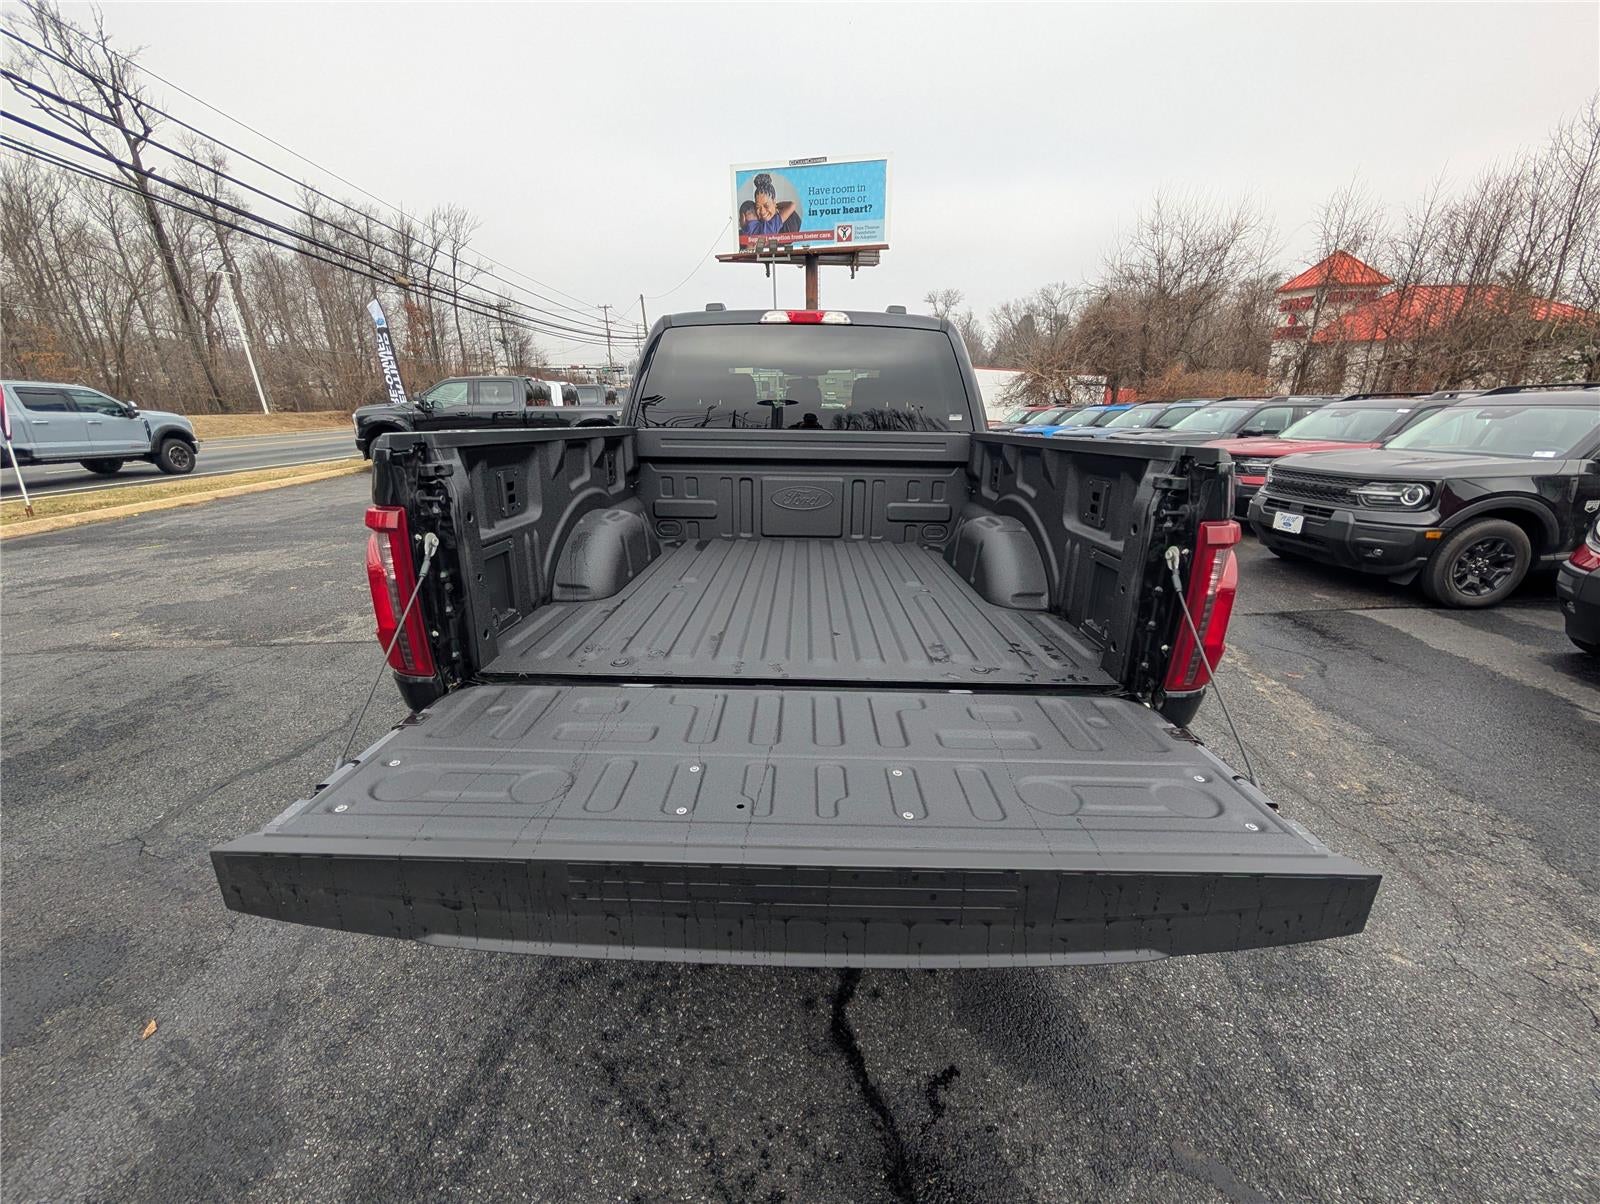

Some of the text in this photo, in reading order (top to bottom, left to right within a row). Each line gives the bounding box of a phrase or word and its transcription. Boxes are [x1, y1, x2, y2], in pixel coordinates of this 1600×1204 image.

[808, 184, 866, 195] Have room in
[808, 195, 867, 208] your home or
[808, 204, 873, 218] in your heart?
[783, 489, 822, 505] Ford
